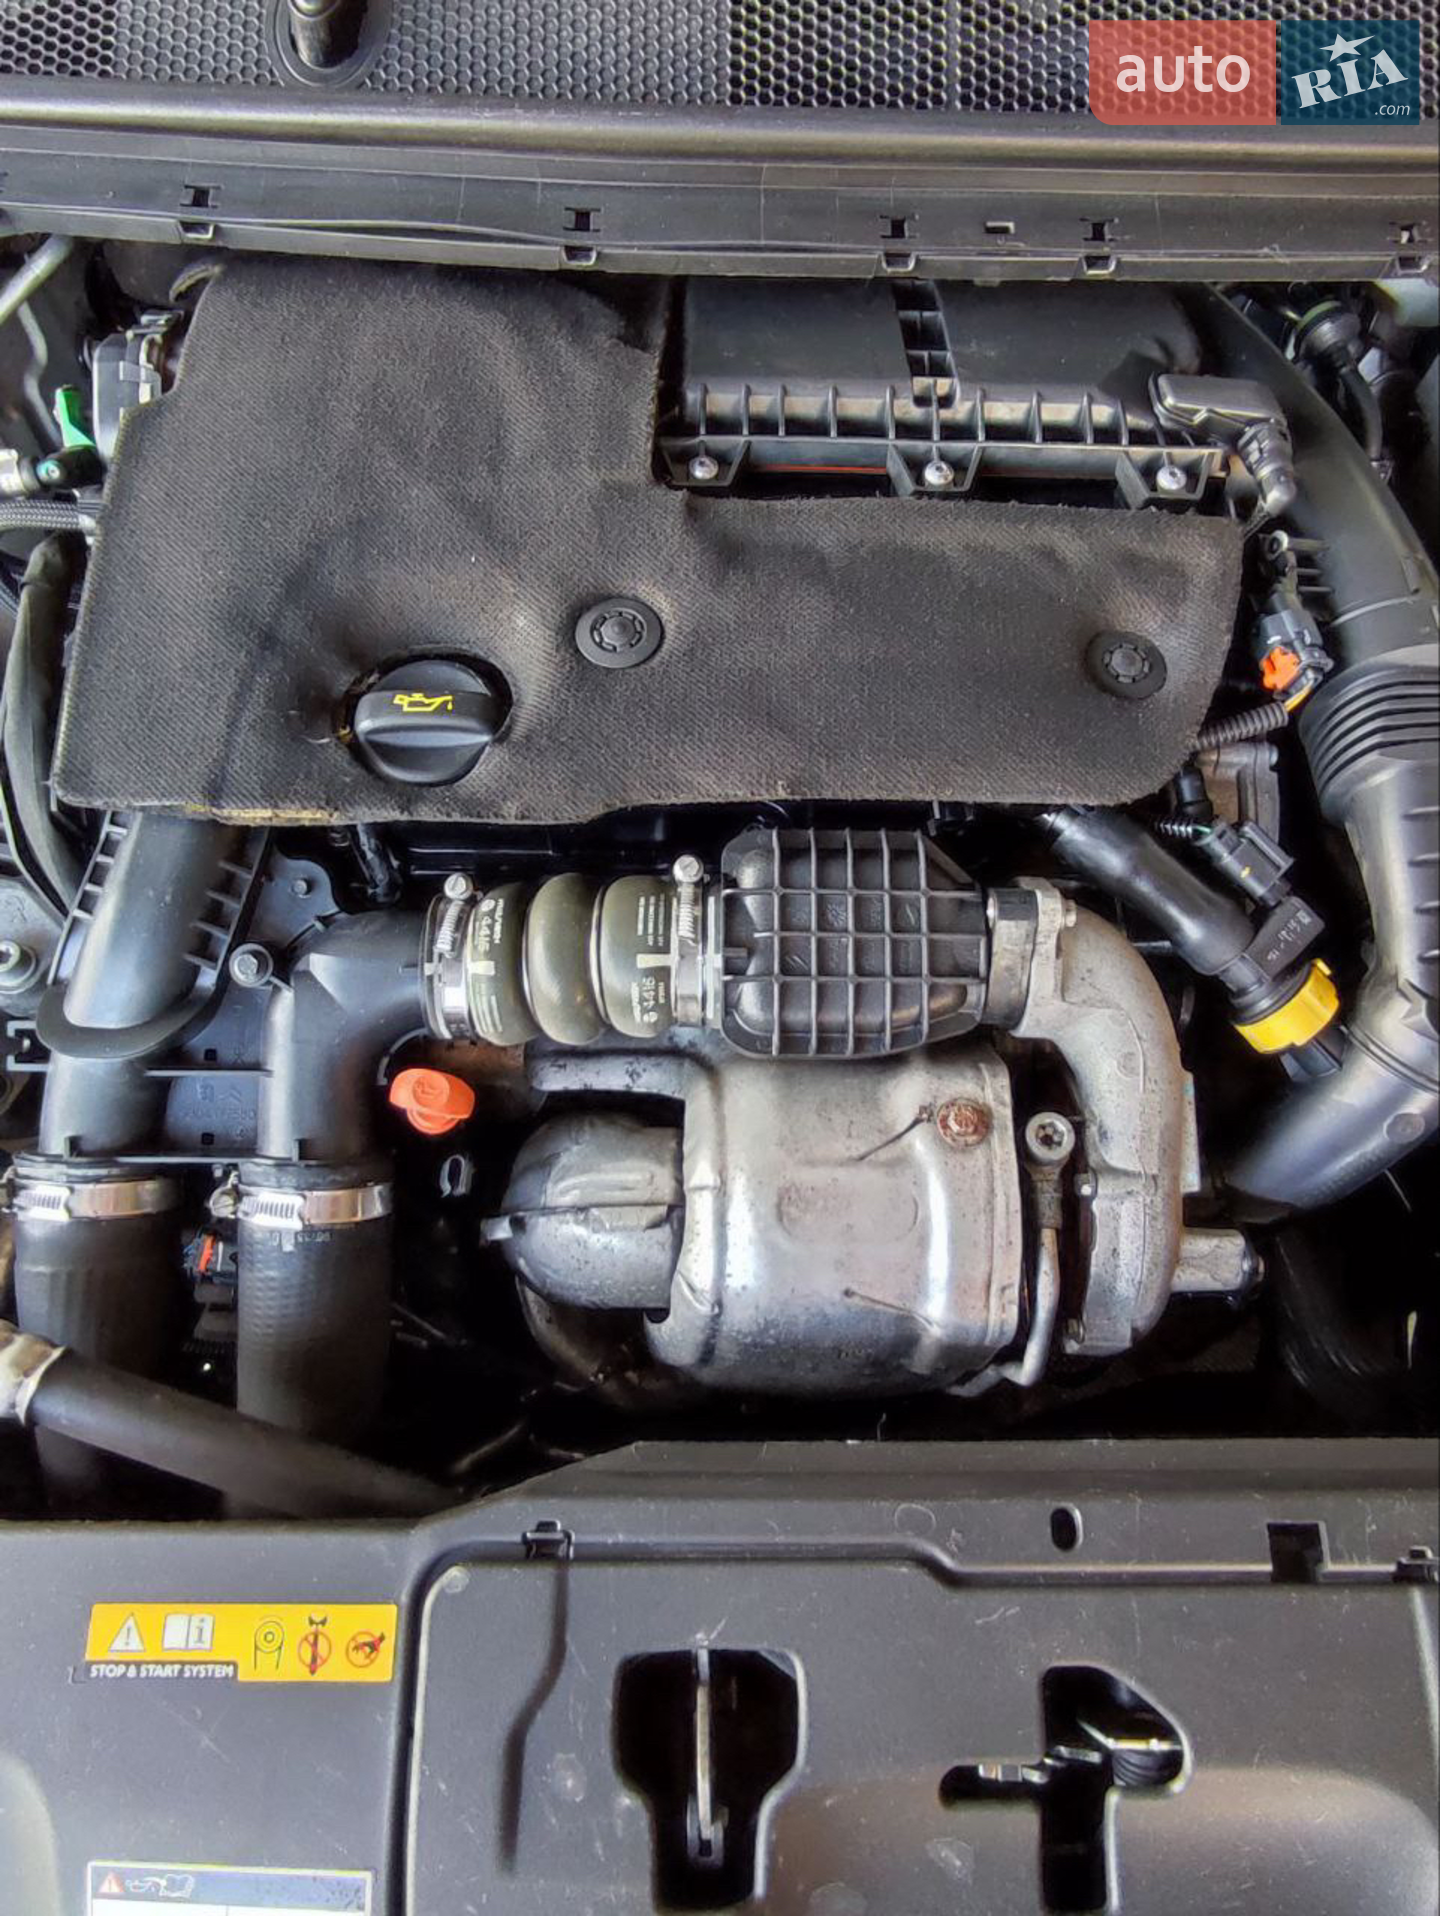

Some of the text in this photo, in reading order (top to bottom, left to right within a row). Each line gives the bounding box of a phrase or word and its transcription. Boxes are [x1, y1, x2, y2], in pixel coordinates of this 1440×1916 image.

[90, 1664, 233, 1678] STOP & START SYSTEM
